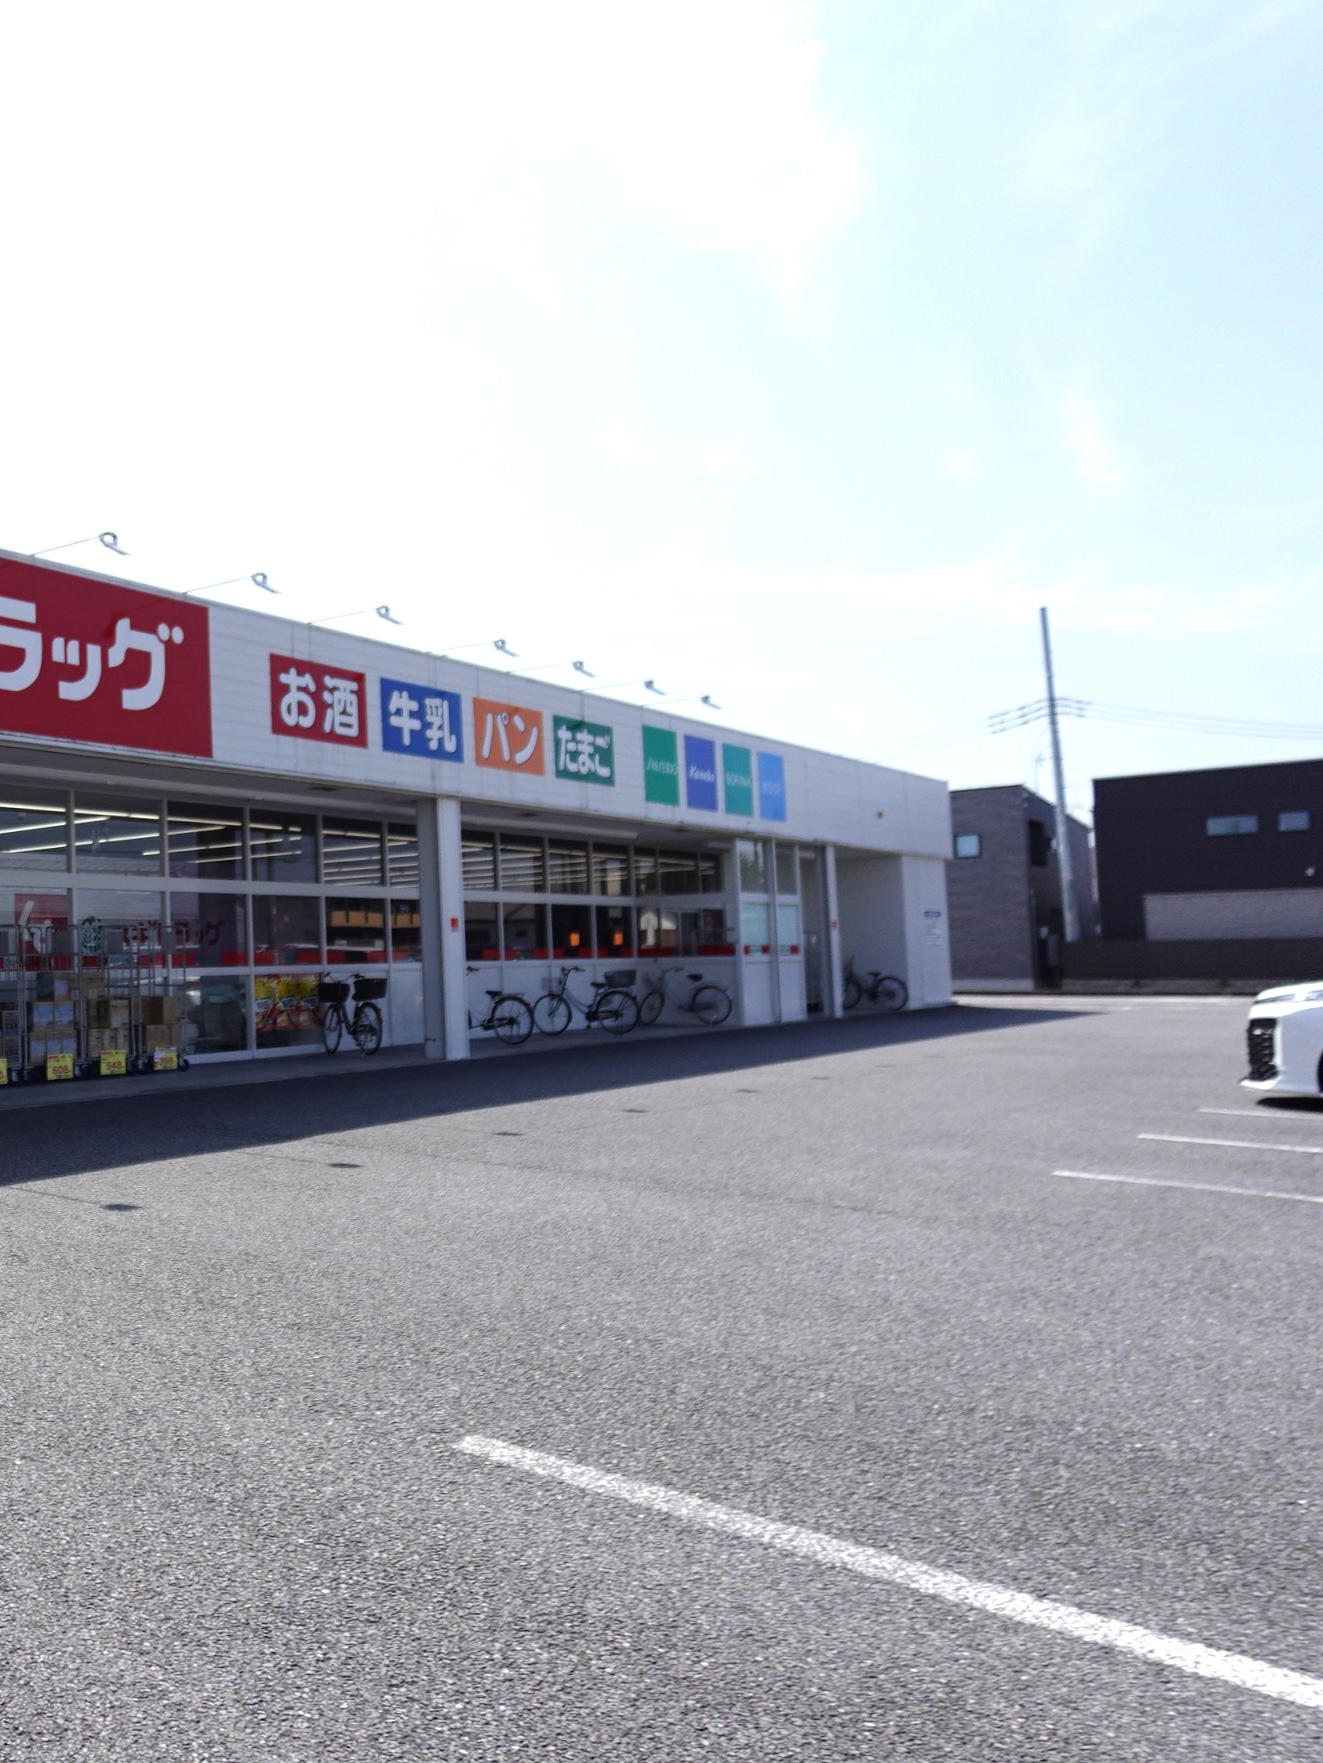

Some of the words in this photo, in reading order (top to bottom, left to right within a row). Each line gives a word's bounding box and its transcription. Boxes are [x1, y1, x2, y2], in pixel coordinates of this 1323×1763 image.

[279, 667, 359, 738] お酒
[388, 690, 456, 753] 牛乳
[482, 712, 539, 765] パン
[557, 725, 611, 778] たまご
